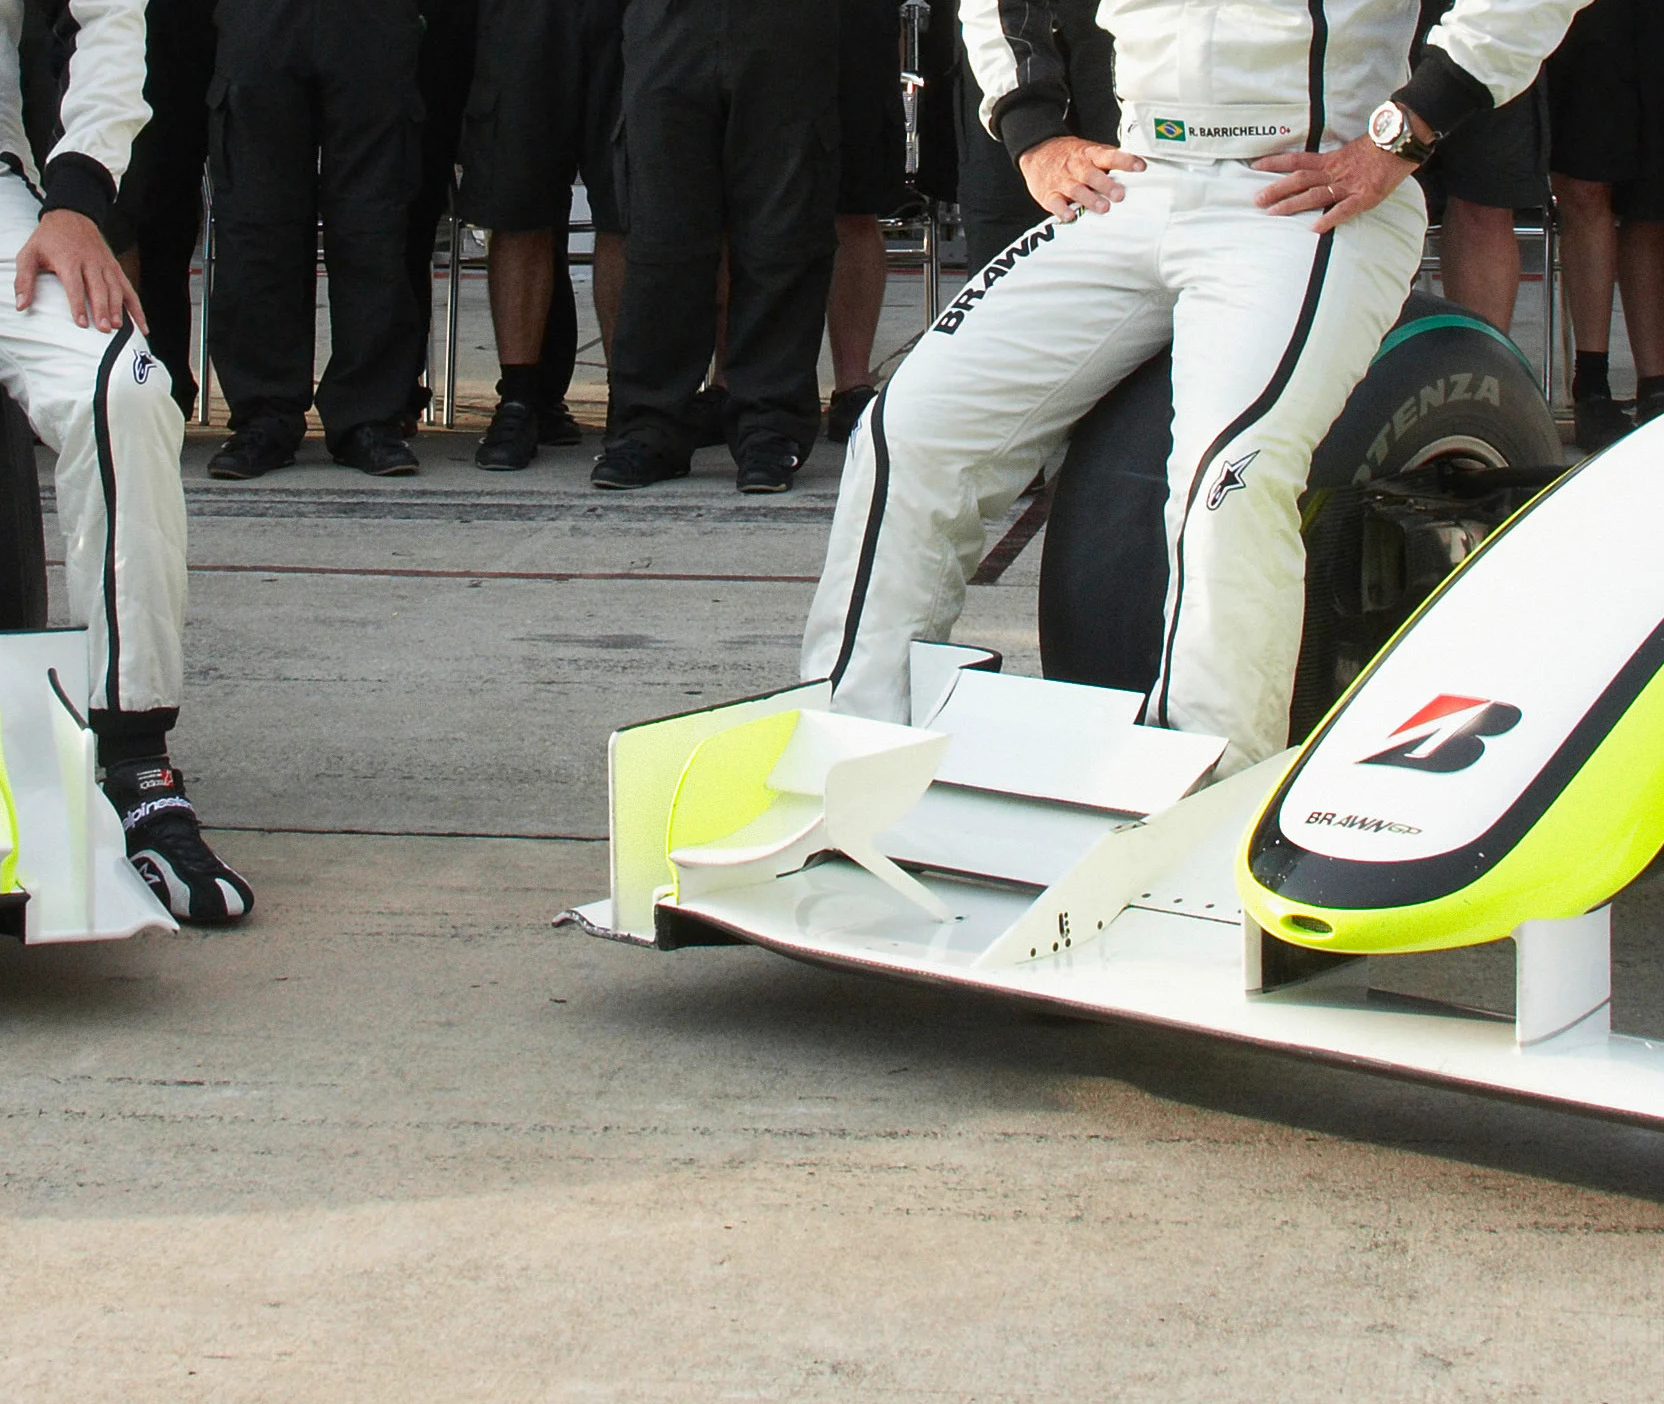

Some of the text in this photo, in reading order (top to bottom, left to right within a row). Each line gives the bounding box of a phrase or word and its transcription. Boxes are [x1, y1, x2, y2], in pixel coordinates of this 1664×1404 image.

[1201, 126, 1276, 137] BARRICHELLO
[933, 208, 1082, 335] BRAWN
[1350, 372, 1500, 487] TENZA
